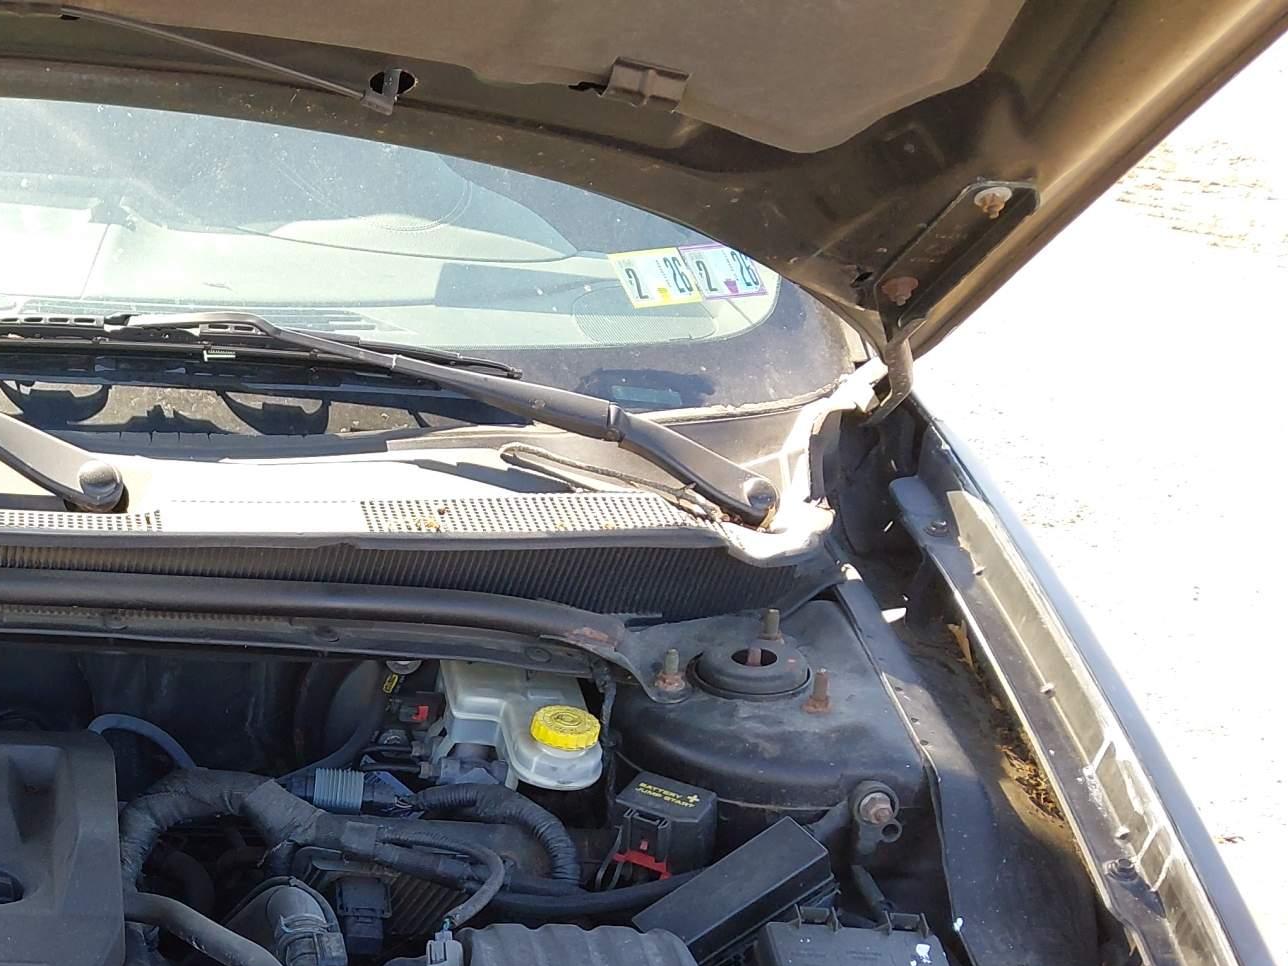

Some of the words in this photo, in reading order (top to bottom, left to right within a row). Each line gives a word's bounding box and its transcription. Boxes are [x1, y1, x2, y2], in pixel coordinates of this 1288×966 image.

[625, 268, 649, 299] 2
[663, 256, 694, 293] 26
[696, 260, 718, 292] 2
